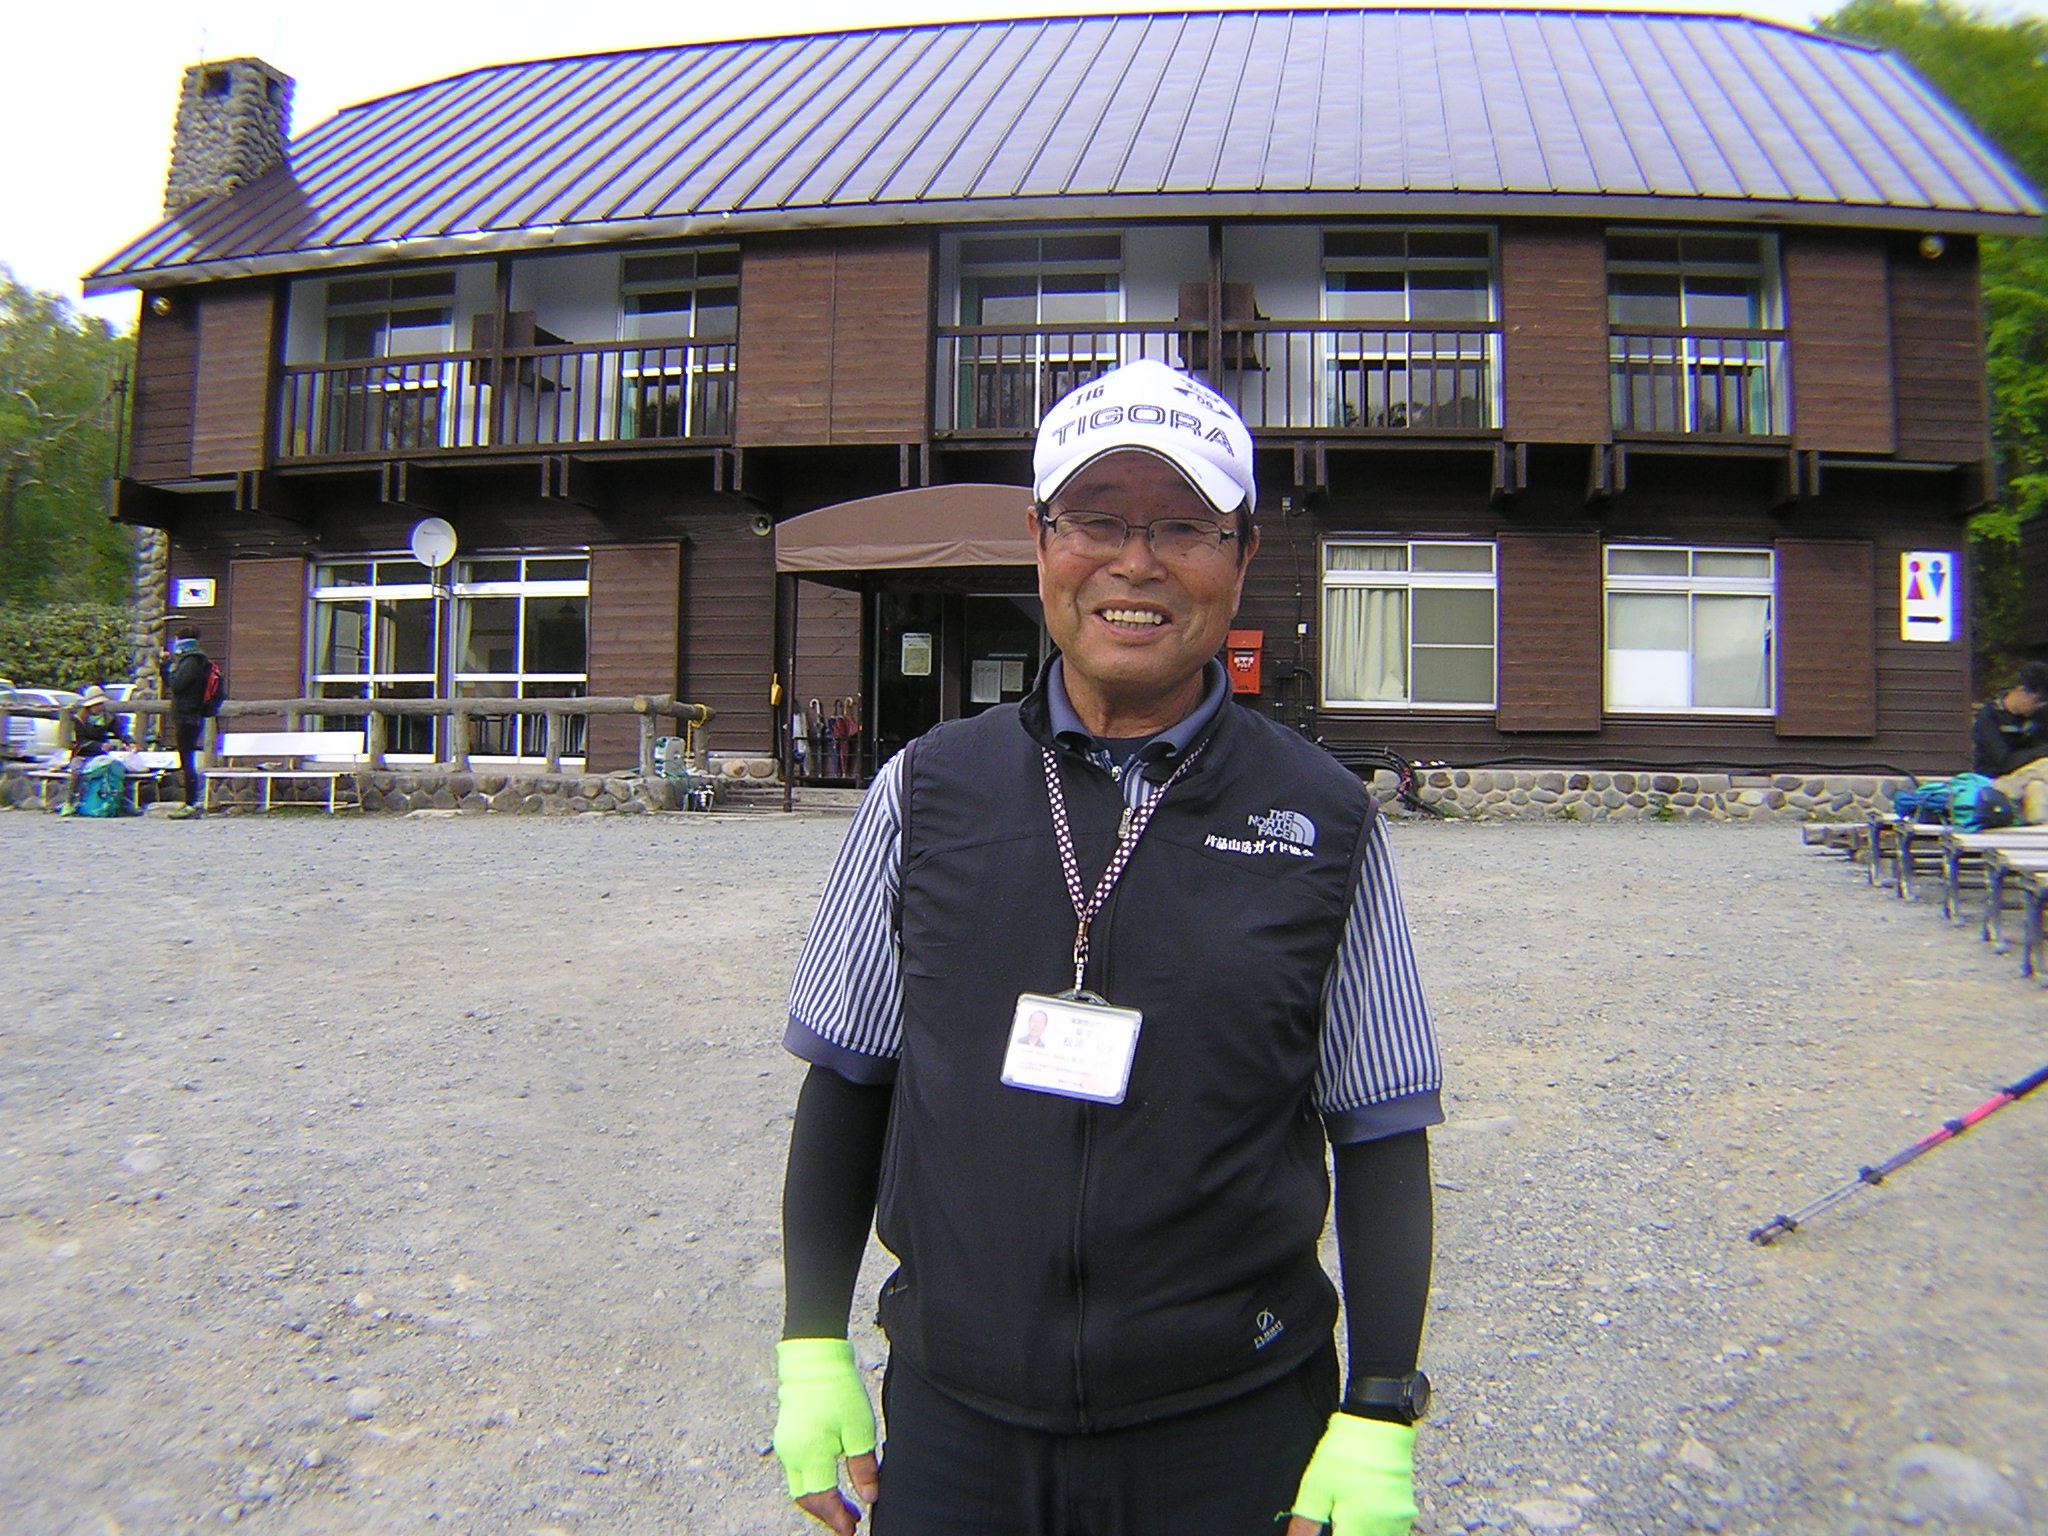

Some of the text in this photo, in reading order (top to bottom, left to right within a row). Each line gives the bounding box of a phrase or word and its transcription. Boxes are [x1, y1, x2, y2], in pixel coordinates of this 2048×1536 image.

[1052, 404, 1235, 458] TIGORA
[1247, 814, 1293, 831] NORTH
[1269, 809, 1294, 820] THE
[1257, 824, 1291, 840] FACE
